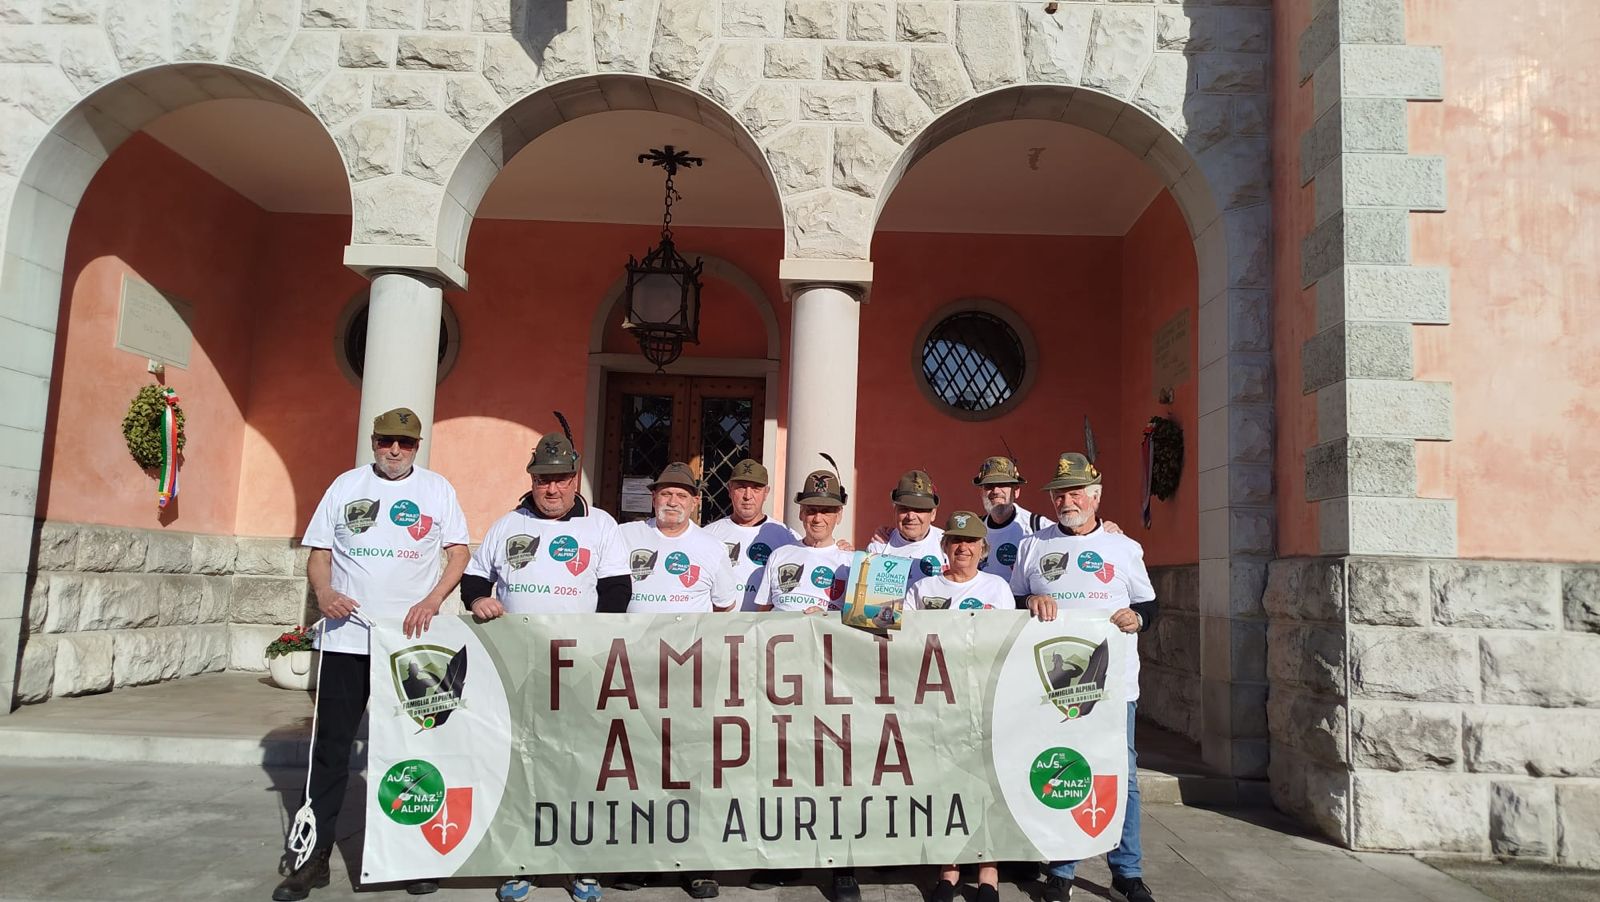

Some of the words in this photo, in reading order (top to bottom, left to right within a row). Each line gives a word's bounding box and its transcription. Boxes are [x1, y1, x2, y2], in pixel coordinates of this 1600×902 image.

[348, 547, 394, 558] GENOVA
[883, 560, 898, 573] 97
[876, 572, 906, 581] ADUNATA
[507, 583, 551, 593] GENOVA
[554, 586, 578, 596] 2026
[874, 585, 903, 594] GENOVA
[631, 592, 667, 602] GENOVA
[669, 594, 689, 602] 2026
[779, 595, 815, 605] GENOVA
[1088, 591, 1109, 600] 2026
[550, 634, 956, 711] FAMIGLIA
[1048, 689, 1074, 699] FAMIGLIA
[1075, 683, 1097, 694] ALPINA
[402, 698, 430, 710] FAMIGLIA
[596, 713, 914, 792] ALPINA
[1051, 789, 1083, 798] ALPINI
[400, 804, 434, 813] ALPINI
[535, 799, 690, 847] DUINO
[722, 793, 970, 843] AURISINA
